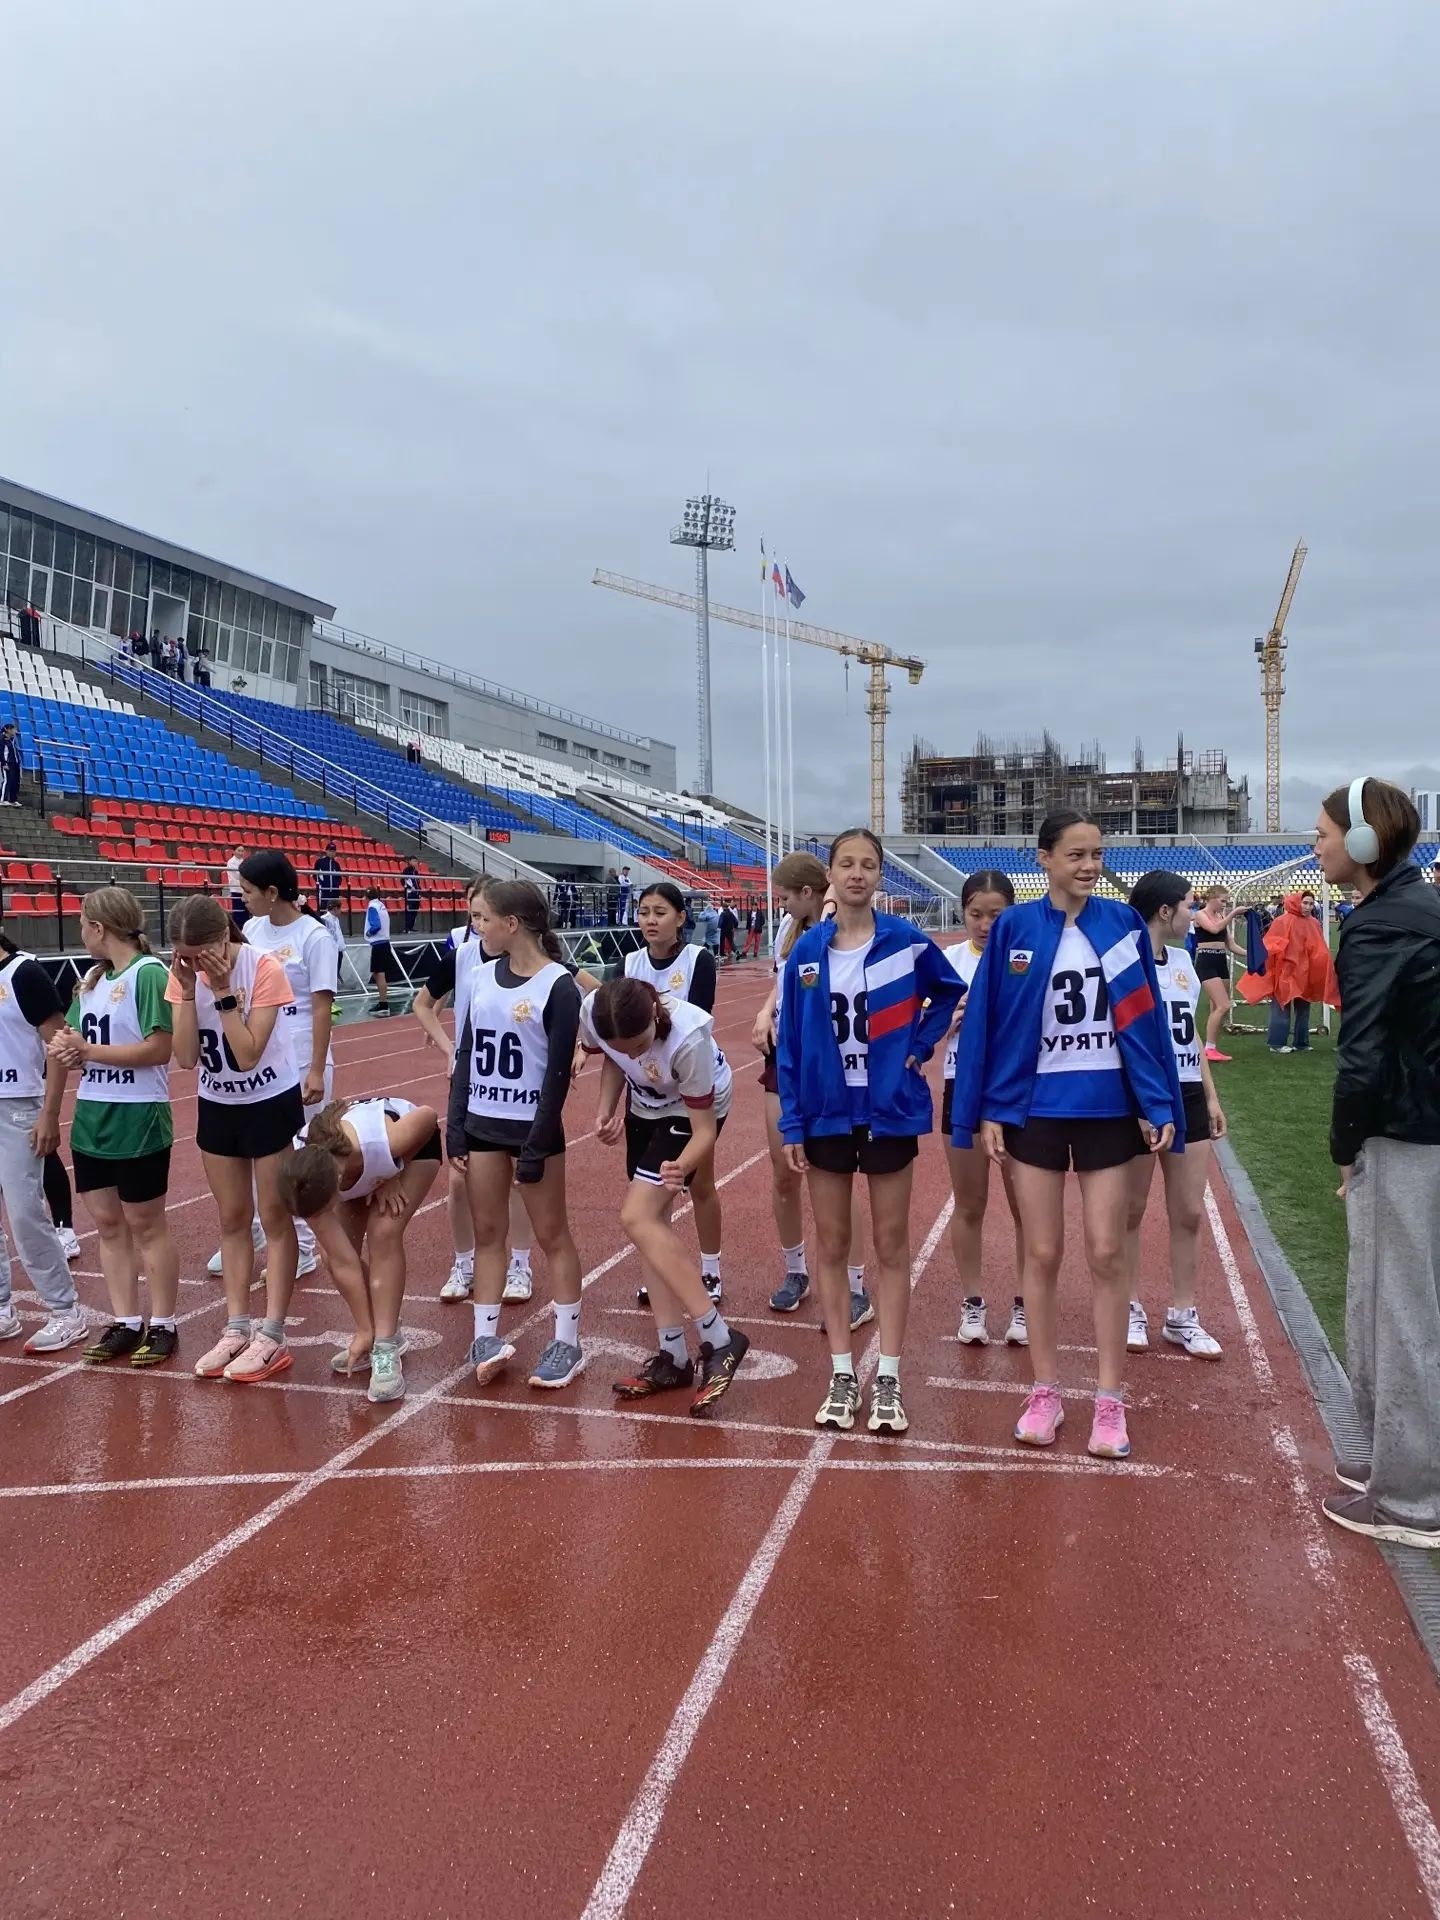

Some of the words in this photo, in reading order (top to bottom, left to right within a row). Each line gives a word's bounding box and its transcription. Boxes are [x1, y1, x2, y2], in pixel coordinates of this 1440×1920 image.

[1052, 966, 1109, 1025] 37
[81, 1012, 111, 1046] 61
[1039, 1030, 1117, 1053] УРЯТИ
[1163, 1000, 1195, 1046] 5
[475, 1028, 523, 1080] 56
[200, 1065, 278, 1093] БУРЯТИЯ
